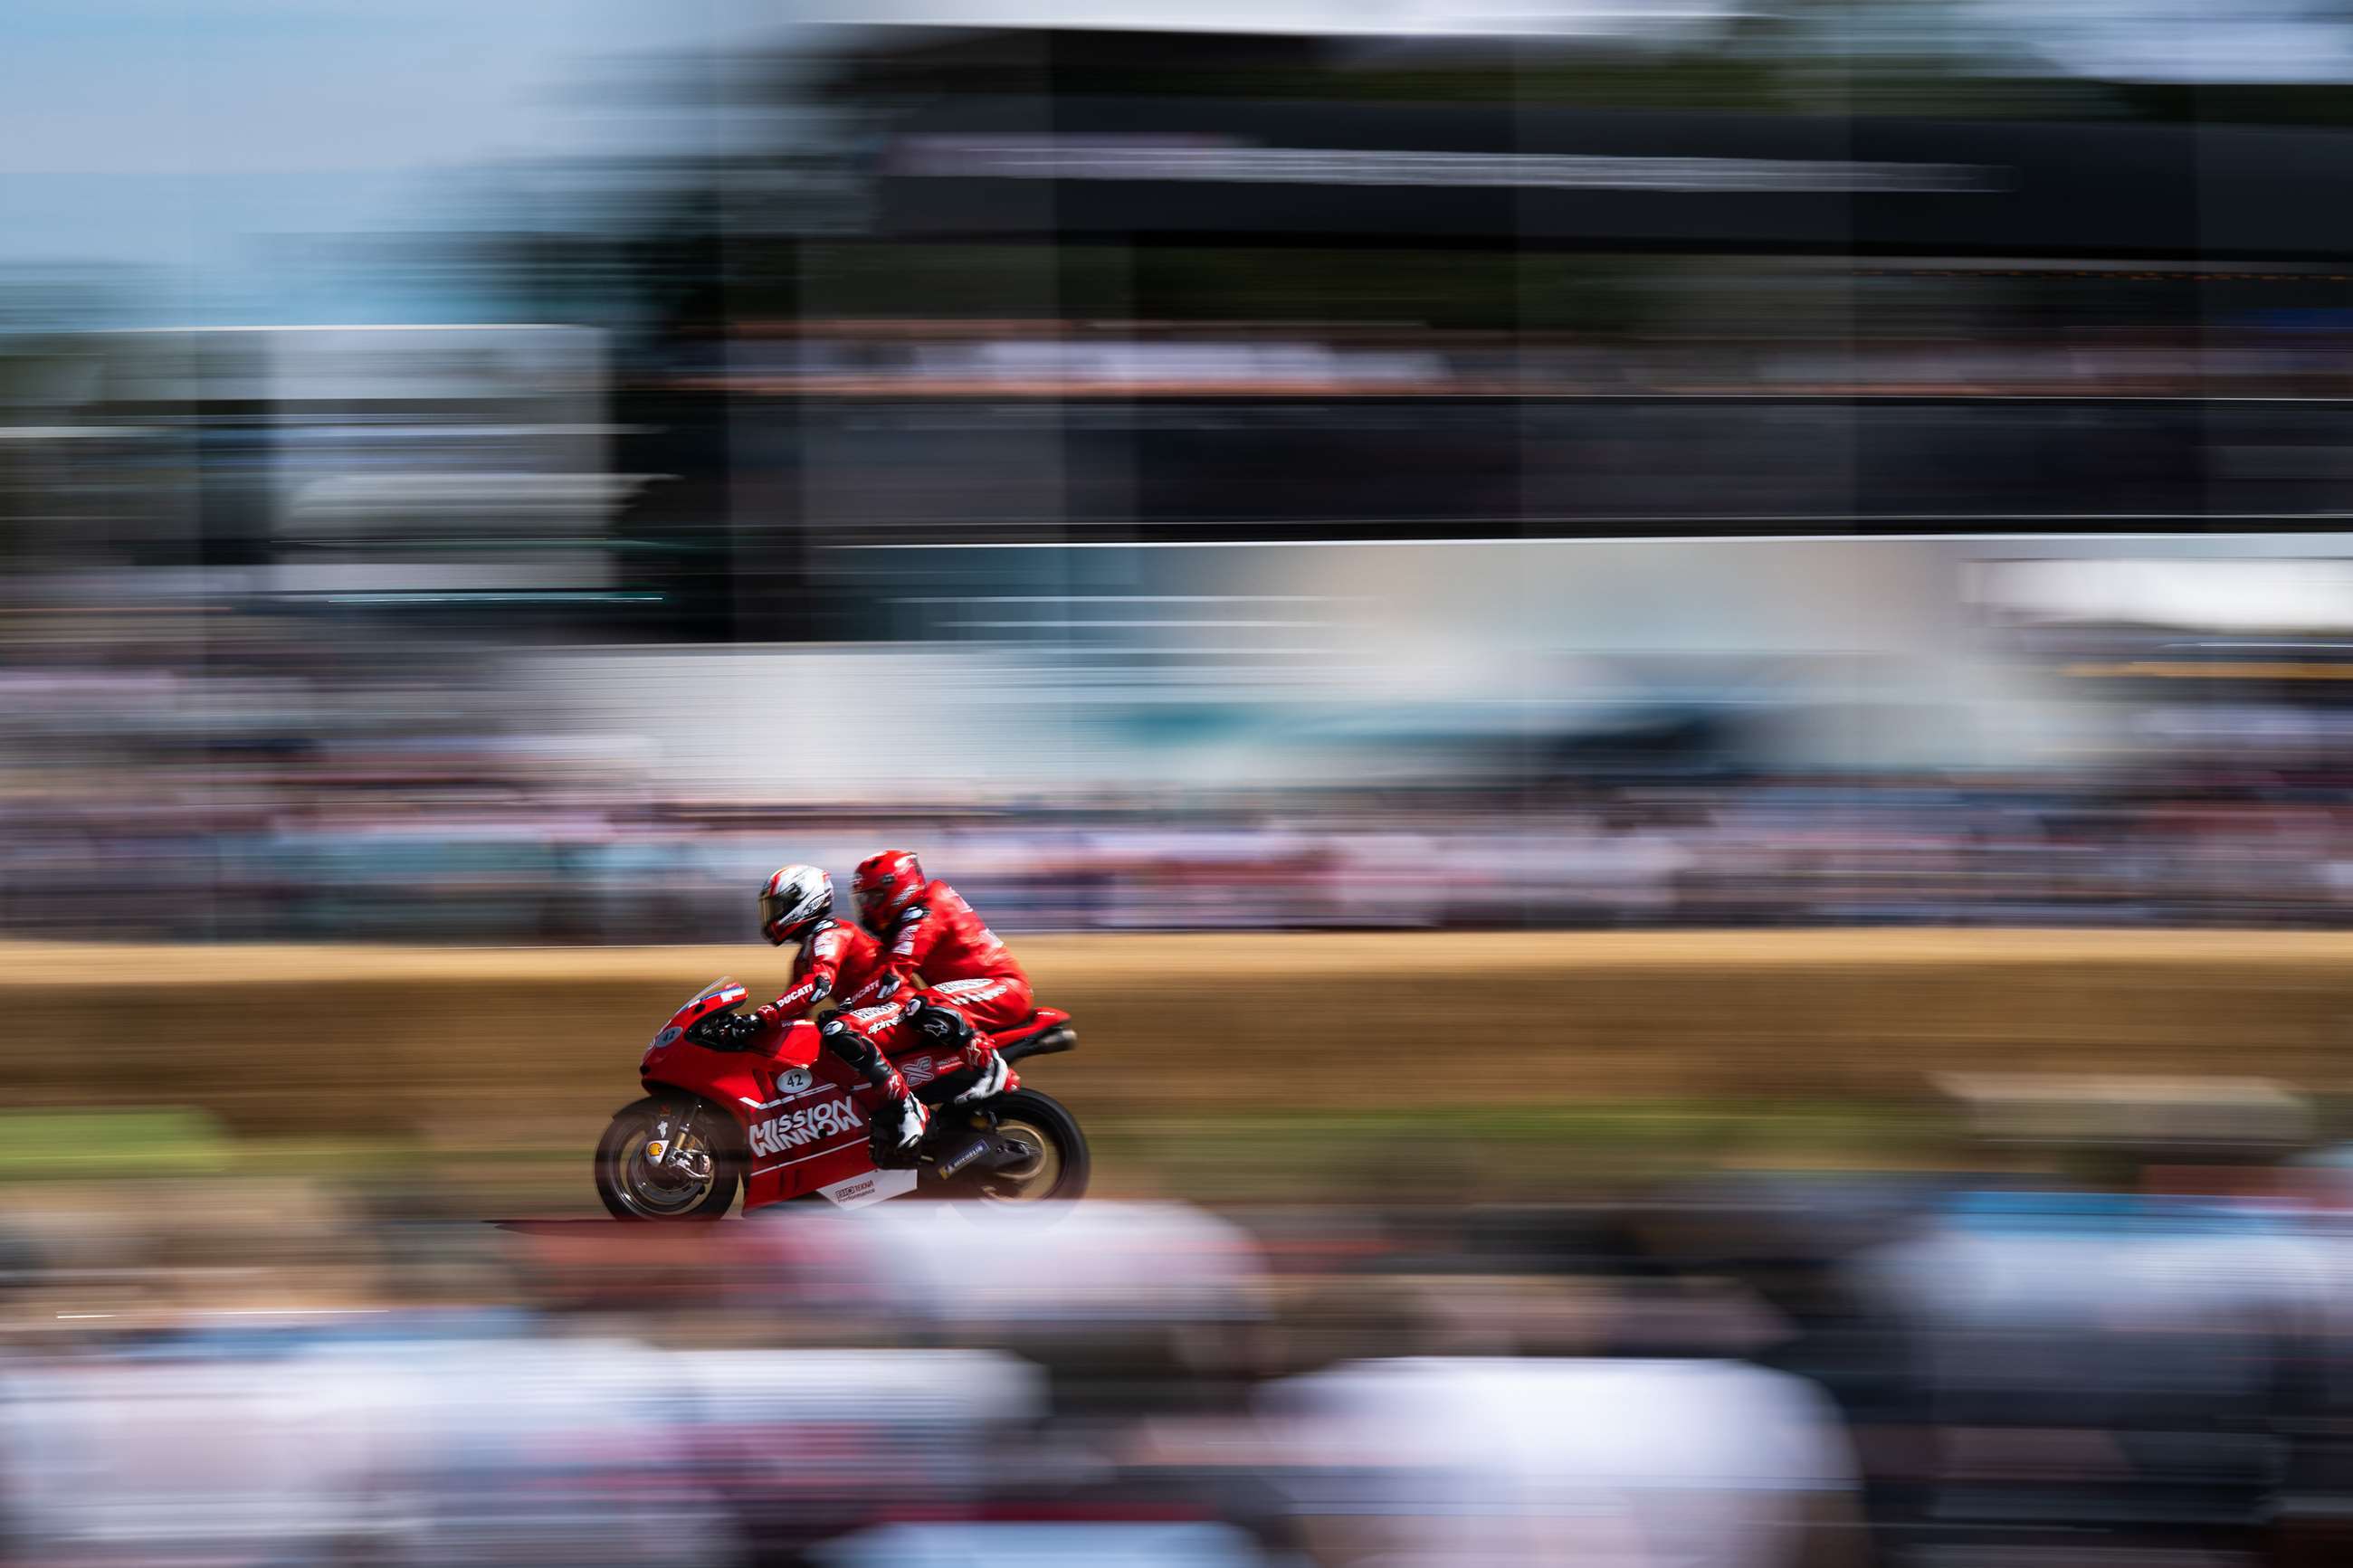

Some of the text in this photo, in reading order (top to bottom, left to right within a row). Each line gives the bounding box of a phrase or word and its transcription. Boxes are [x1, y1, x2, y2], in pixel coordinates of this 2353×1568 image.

[776, 983, 814, 1008] DUCATI
[786, 1074, 804, 1088] 42
[748, 1096, 857, 1142] MISSION
[749, 1112, 864, 1157] WINNOW
